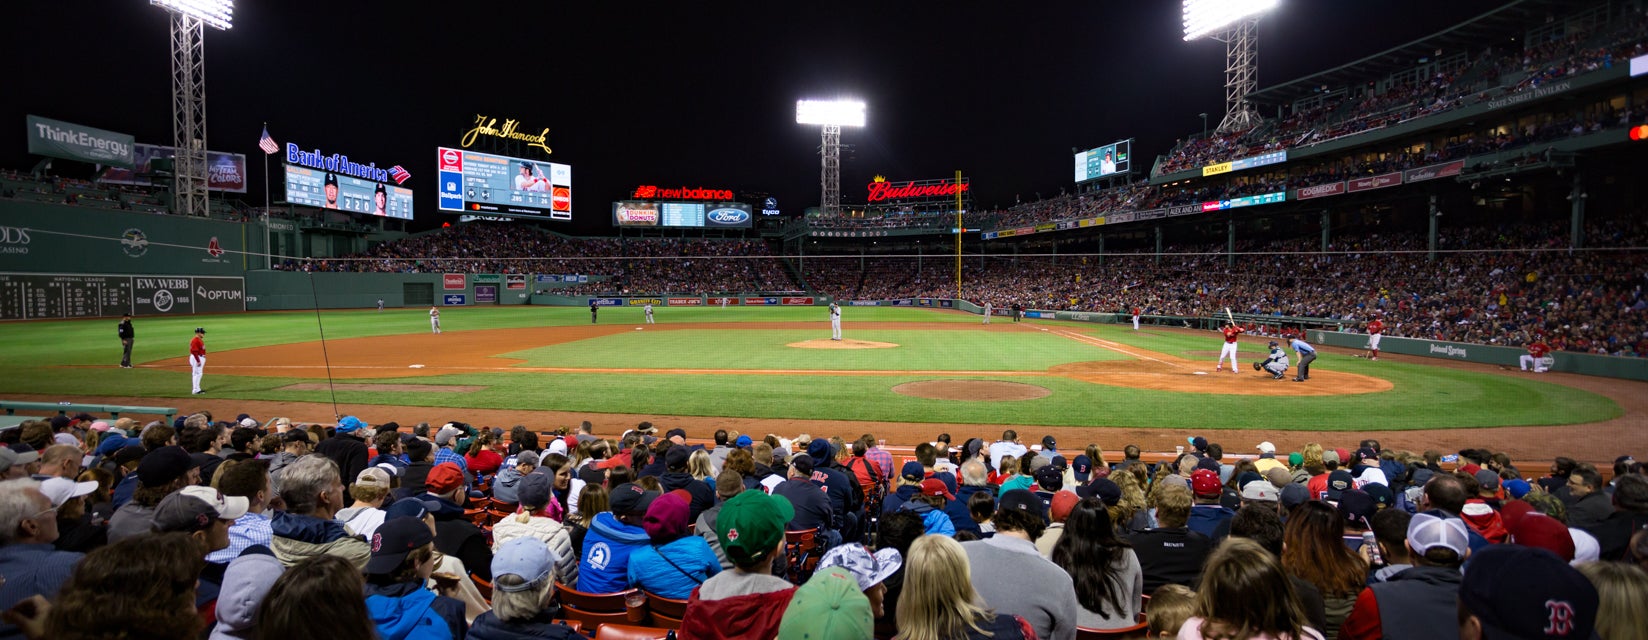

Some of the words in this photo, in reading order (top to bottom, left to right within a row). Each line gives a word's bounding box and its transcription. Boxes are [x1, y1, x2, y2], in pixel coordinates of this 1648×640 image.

[1488, 100, 1508, 110] STATE
[1508, 92, 1532, 104] STREET
[1534, 82, 1570, 98] PAVILION
[36, 123, 128, 156] ThinkEnergy
[461, 114, 500, 148] John
[498, 118, 552, 154] Hancock
[286, 142, 325, 170] Bank
[325, 153, 340, 172] of
[340, 156, 388, 182] America
[1206, 165, 1228, 174] STANLEY
[658, 188, 682, 198] new
[683, 187, 732, 200] balance
[868, 180, 968, 202] Budweiser
[345, 199, 351, 209] 2
[355, 201, 360, 211] 2
[364, 202, 369, 211] 0
[716, 210, 741, 222] Ford
[158, 279, 189, 289] WEBB
[208, 291, 241, 300] OPTUM
[1430, 344, 1448, 354] Poland
[1448, 346, 1466, 358] Spring
[371, 532, 382, 552] B
[1543, 599, 1575, 636] B
